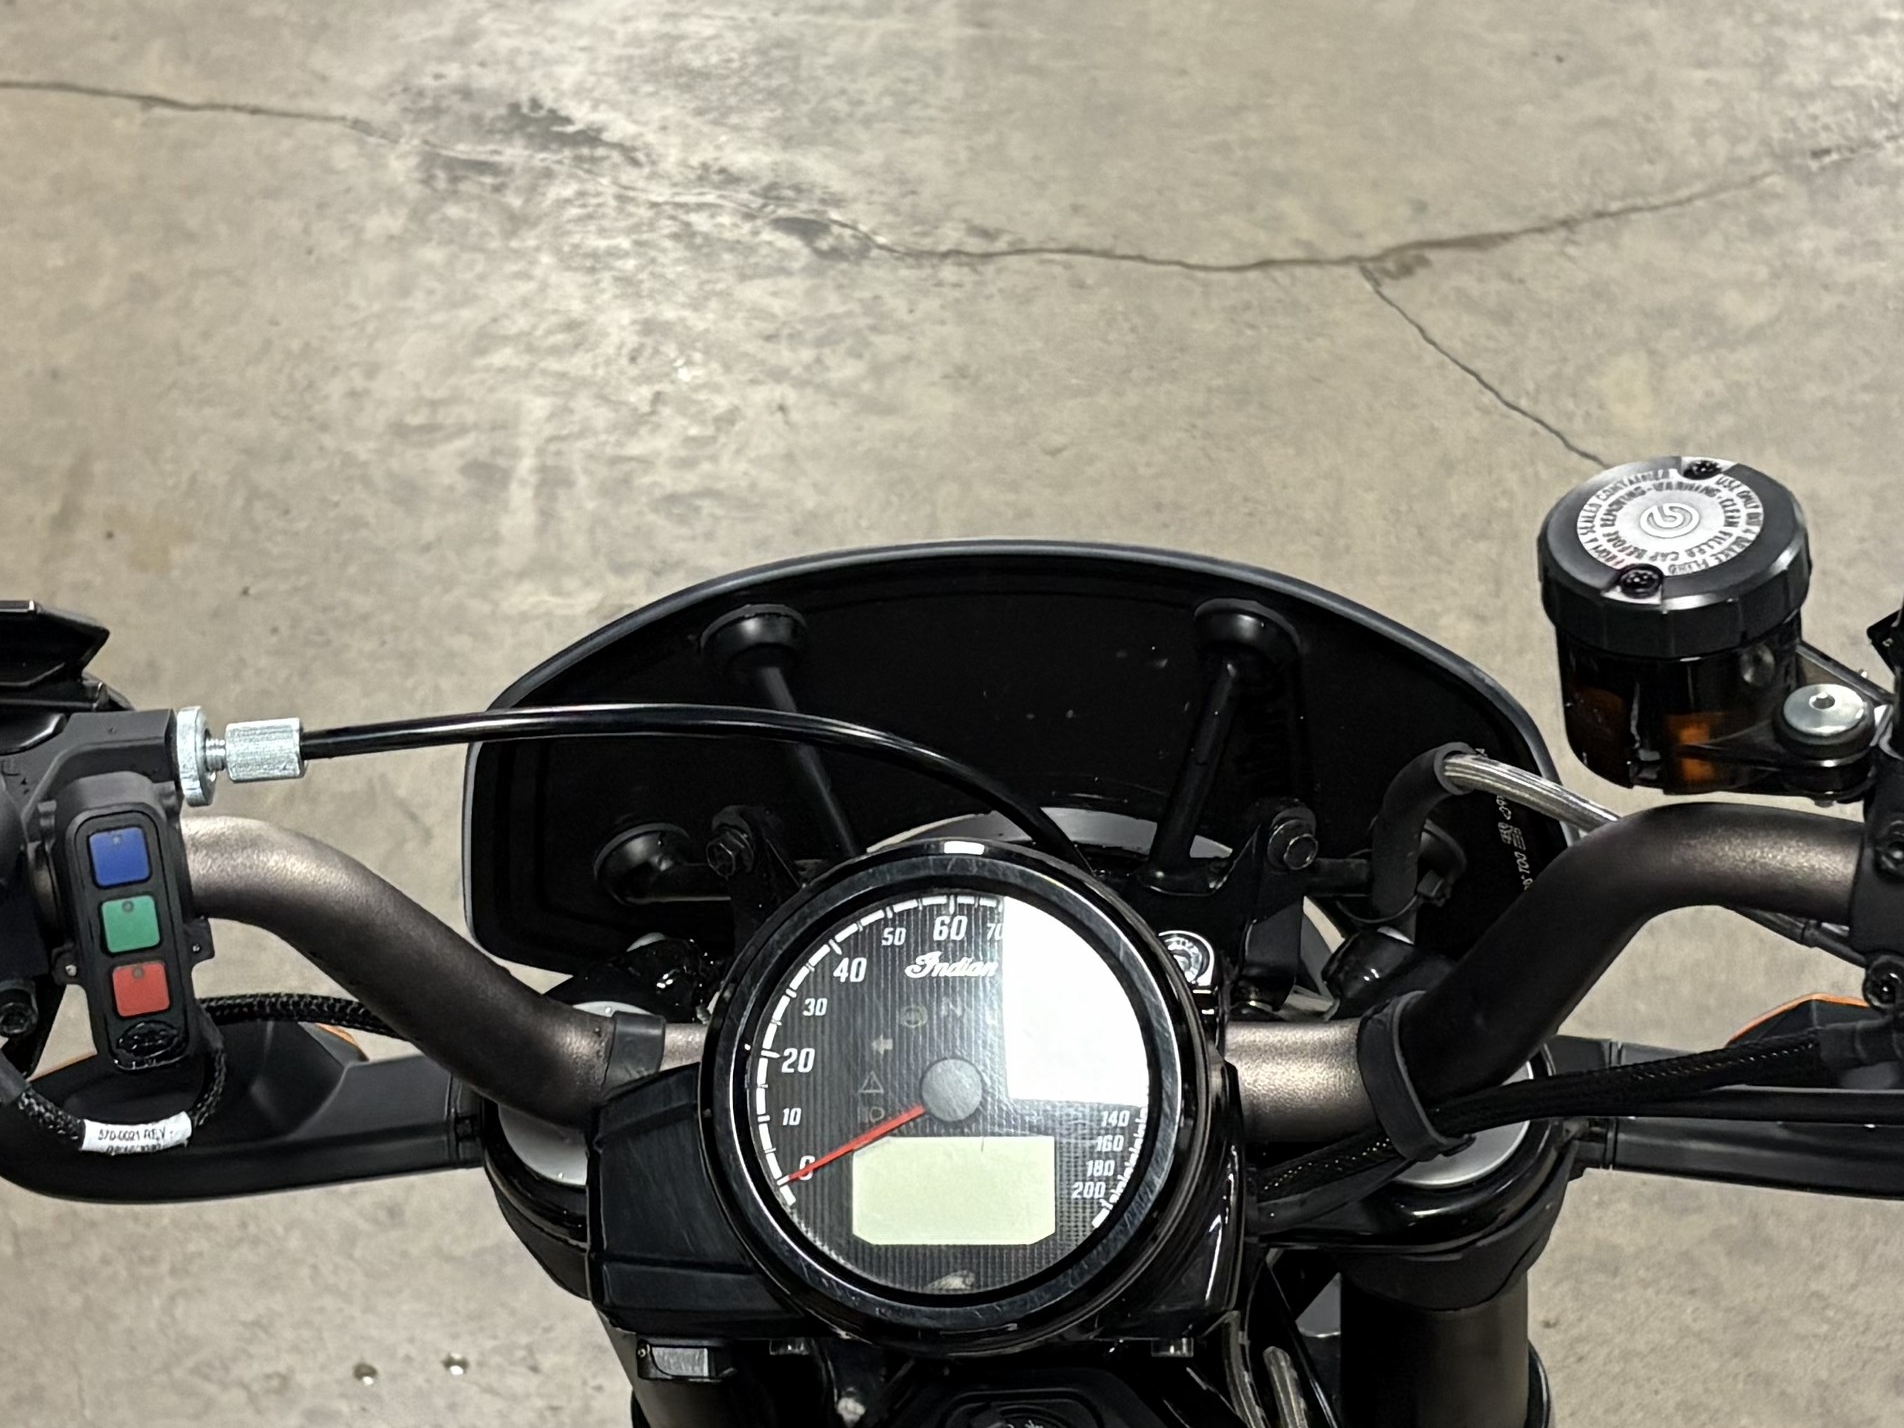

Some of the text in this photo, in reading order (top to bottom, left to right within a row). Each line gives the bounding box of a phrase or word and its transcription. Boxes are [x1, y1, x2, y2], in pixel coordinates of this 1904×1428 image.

[881, 927, 906, 946] 50
[933, 915, 968, 941] 60
[833, 957, 867, 983] 40
[904, 951, 999, 978] Indian
[802, 997, 828, 1016] 30
[782, 1048, 815, 1073] 20
[782, 1108, 802, 1126] 10
[1100, 1110, 1130, 1127] 140
[1096, 1134, 1124, 1152] 160
[799, 1155, 816, 1180] 0
[1086, 1159, 1115, 1177] 180
[1071, 1181, 1106, 1199] 200
